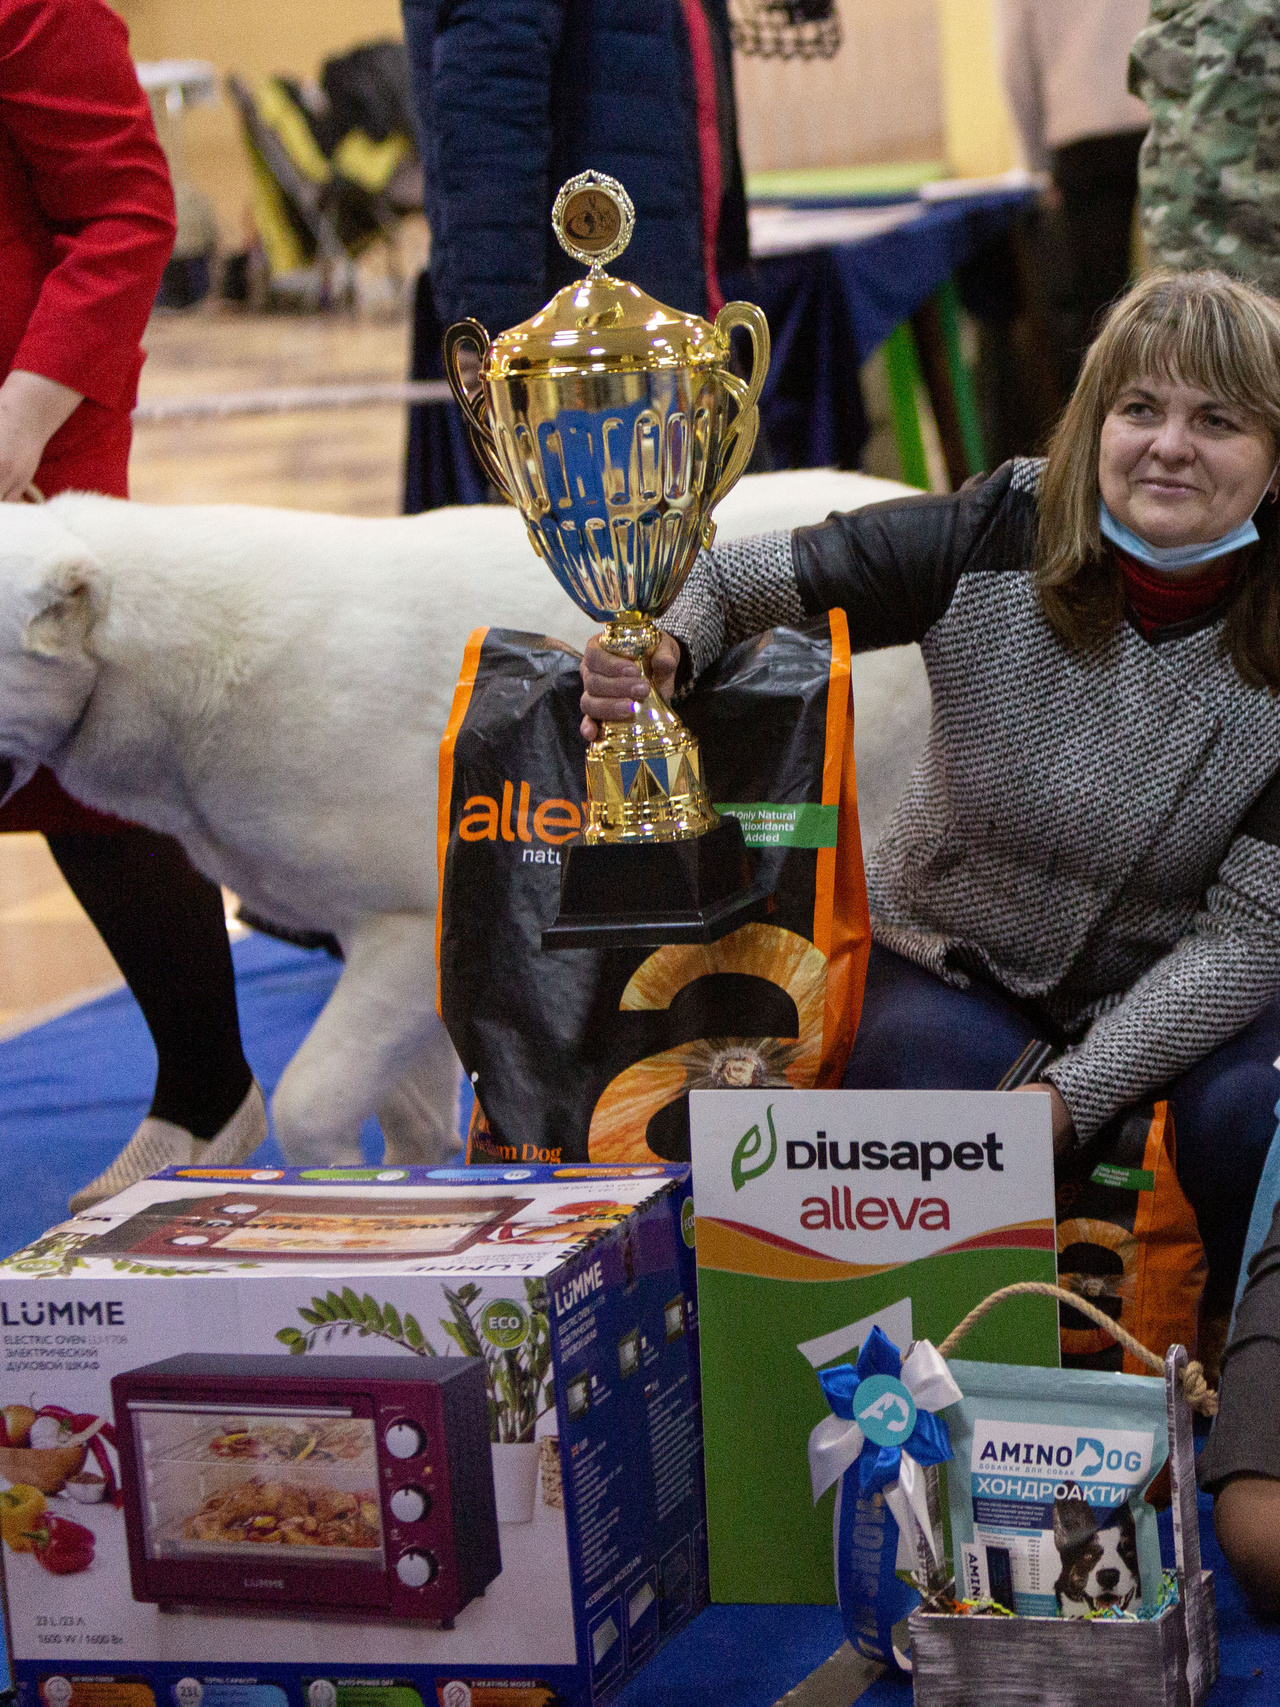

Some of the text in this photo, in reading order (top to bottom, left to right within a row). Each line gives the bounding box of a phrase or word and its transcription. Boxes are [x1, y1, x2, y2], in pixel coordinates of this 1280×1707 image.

[738, 810, 796, 820] Only Natural
[741, 822, 795, 832] tioxidants
[745, 833, 780, 842] Added
[522, 1143, 563, 1164] Dog
[786, 1131, 1004, 1181] Diusapet
[800, 1186, 950, 1230] alleva
[554, 1260, 604, 1317] LÜMME
[1, 1301, 125, 1326] LÜMME
[488, 1316, 520, 1330] ECO
[3, 1335, 53, 1345] ELECTRIC
[55, 1335, 86, 1345] OVEN
